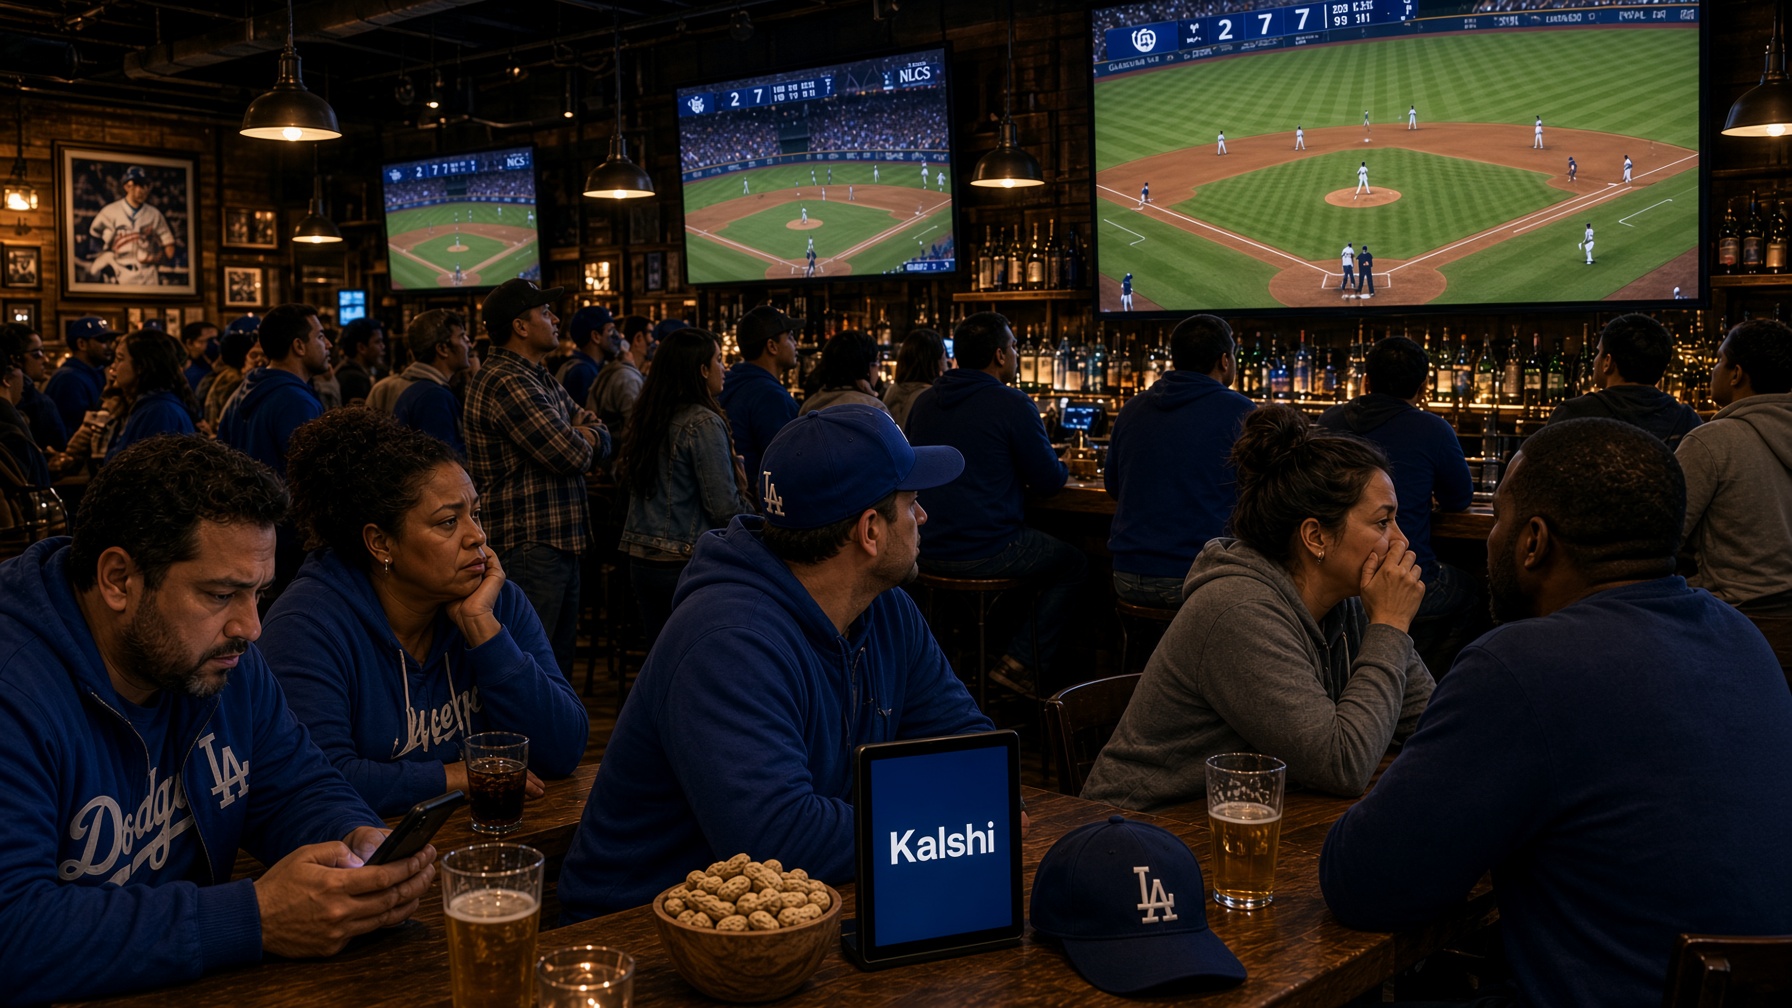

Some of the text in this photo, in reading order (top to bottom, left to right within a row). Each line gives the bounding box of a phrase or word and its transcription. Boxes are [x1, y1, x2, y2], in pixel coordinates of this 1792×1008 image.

[1218, 19, 1233, 40] 2
[1258, 13, 1272, 35] 7
[1295, 8, 1310, 30] 7
[900, 66, 931, 83] NLCS
[730, 92, 740, 107] 2
[754, 89, 763, 103] 7
[416, 166, 422, 177] 2
[432, 165, 438, 175] 7
[763, 471, 785, 517] LA
[198, 732, 250, 810] LA
[890, 821, 995, 864] Kalshi
[1133, 866, 1178, 924] LA
